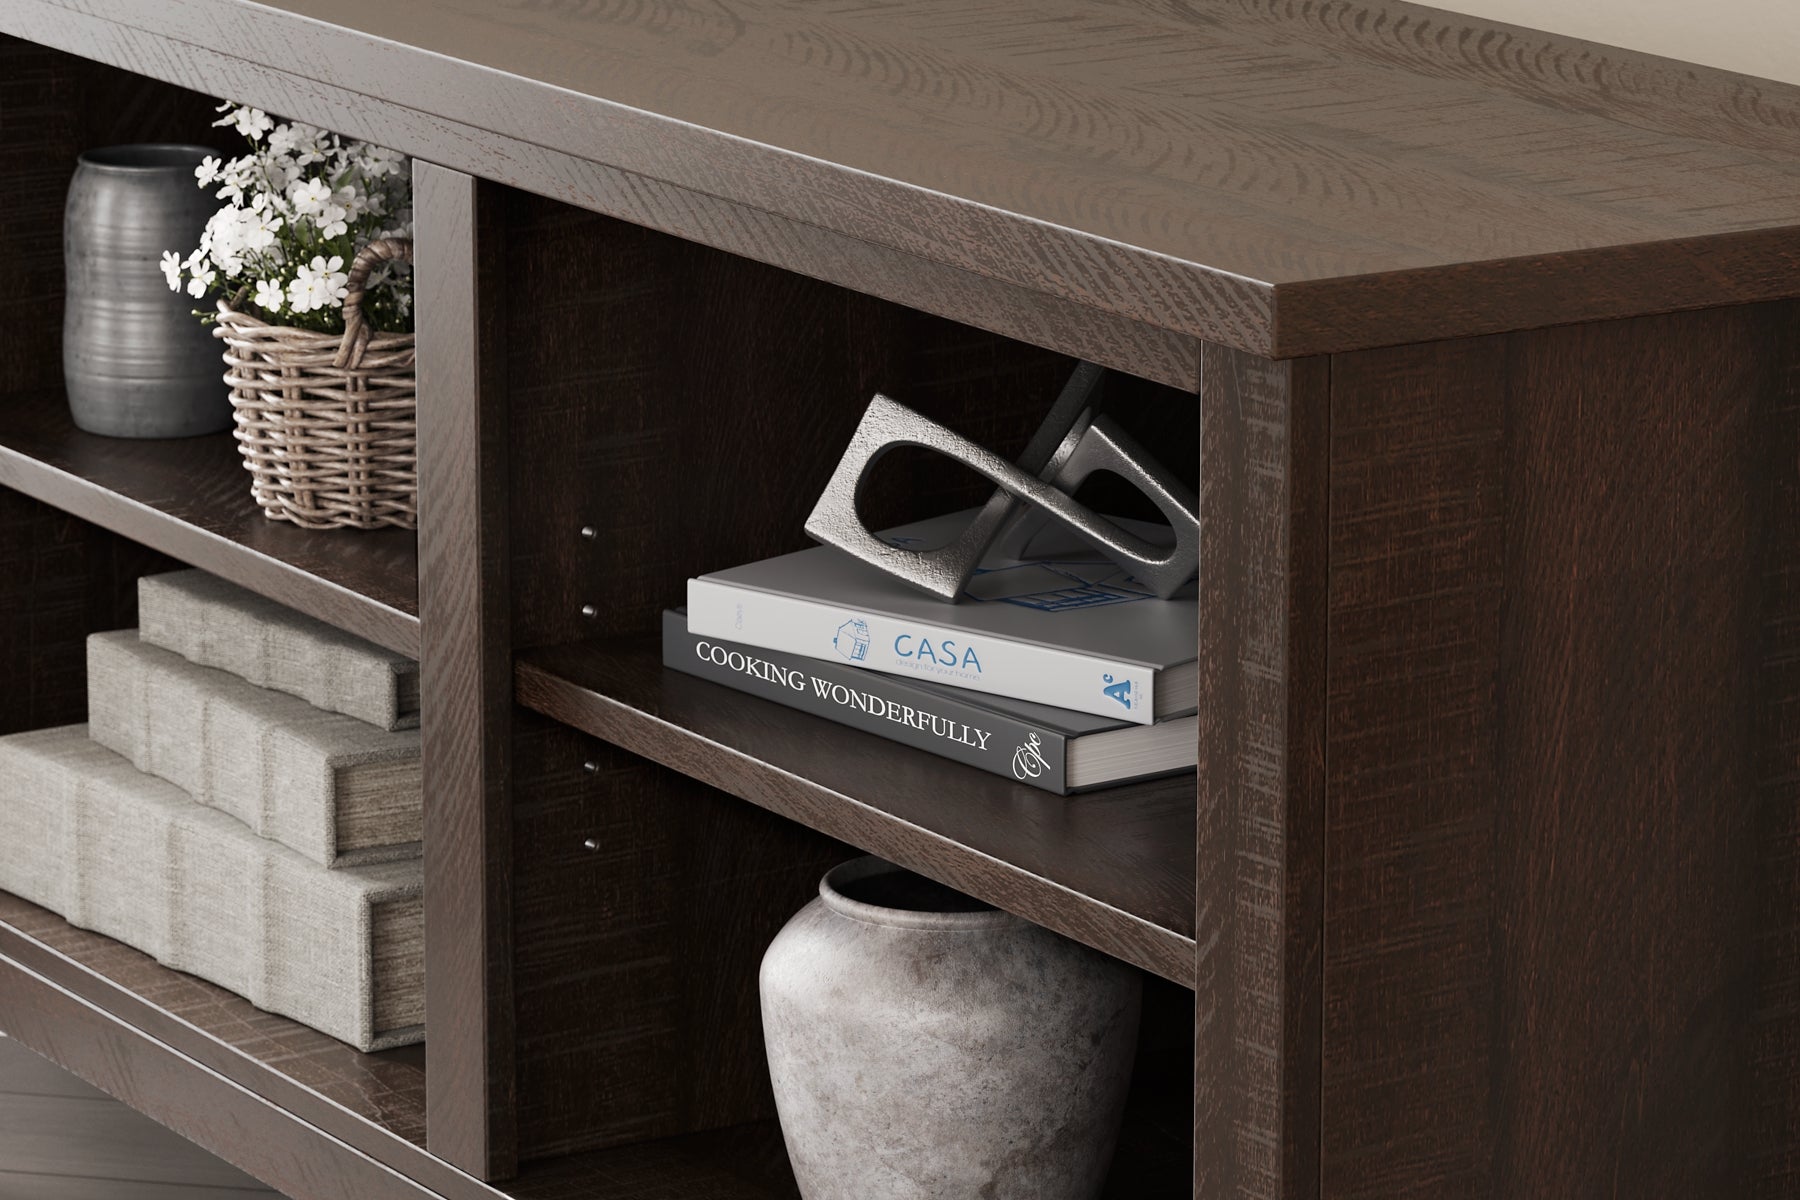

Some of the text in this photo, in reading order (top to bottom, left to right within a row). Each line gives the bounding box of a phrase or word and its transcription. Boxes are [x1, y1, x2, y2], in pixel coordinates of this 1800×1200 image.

[894, 634, 982, 673] CASA
[696, 641, 992, 751] COOKING WONDERFULLY
